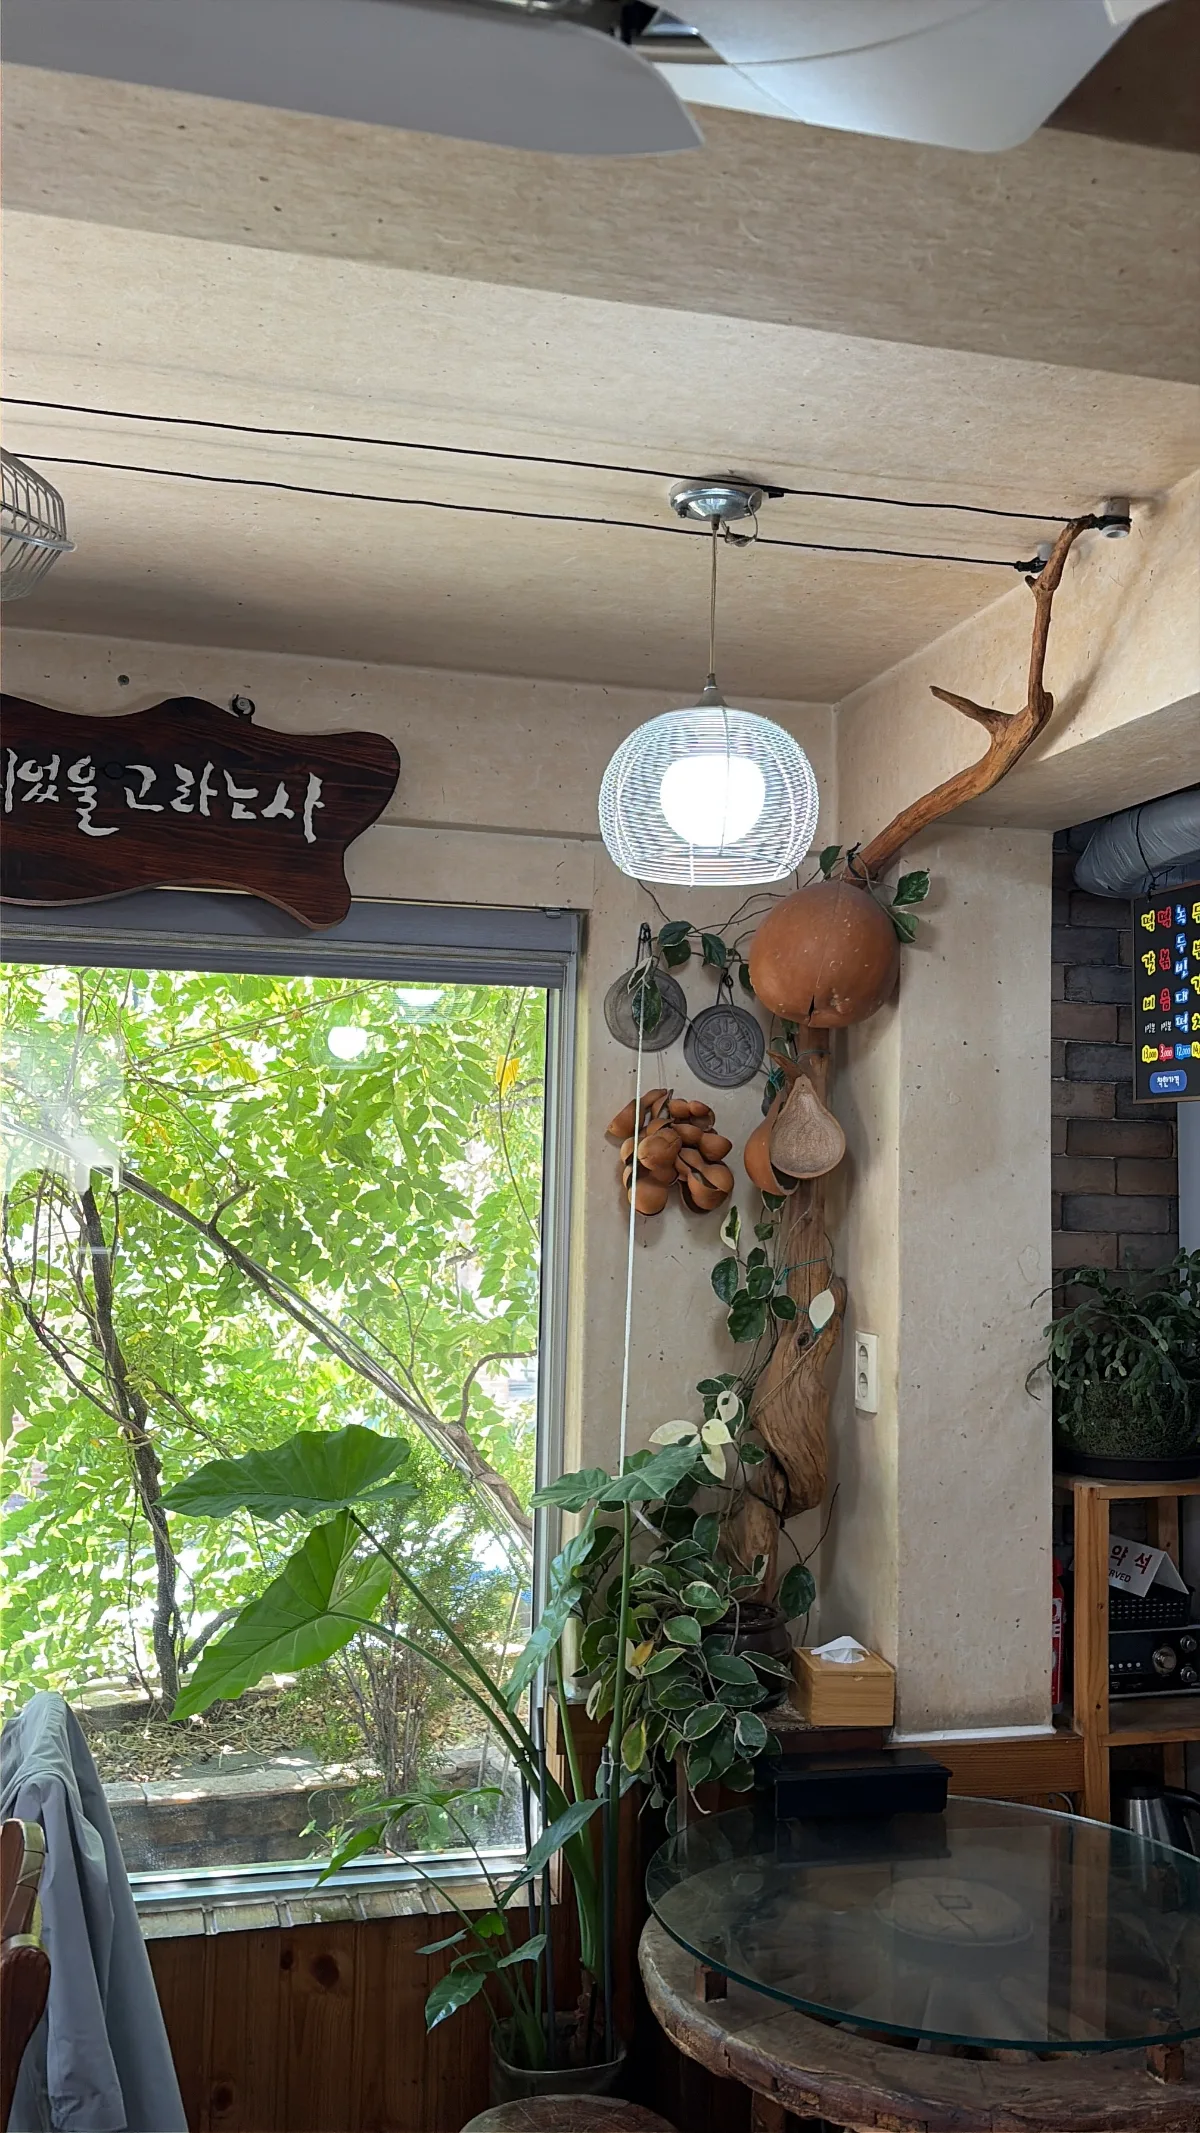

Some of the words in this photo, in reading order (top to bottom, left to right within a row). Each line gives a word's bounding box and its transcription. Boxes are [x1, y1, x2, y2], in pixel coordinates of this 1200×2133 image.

[1141, 909, 1156, 1012] 떡갈비
[1175, 904, 1189, 1033] 녹두빈대떡
[1143, 1047, 1157, 1060] 13,000
[1159, 1046, 1173, 1058] 3,000
[1176, 1045, 1190, 1057] 12,000
[1156, 1075, 1180, 1088] 착한가격
[1108, 1568, 1132, 1583] RVED
